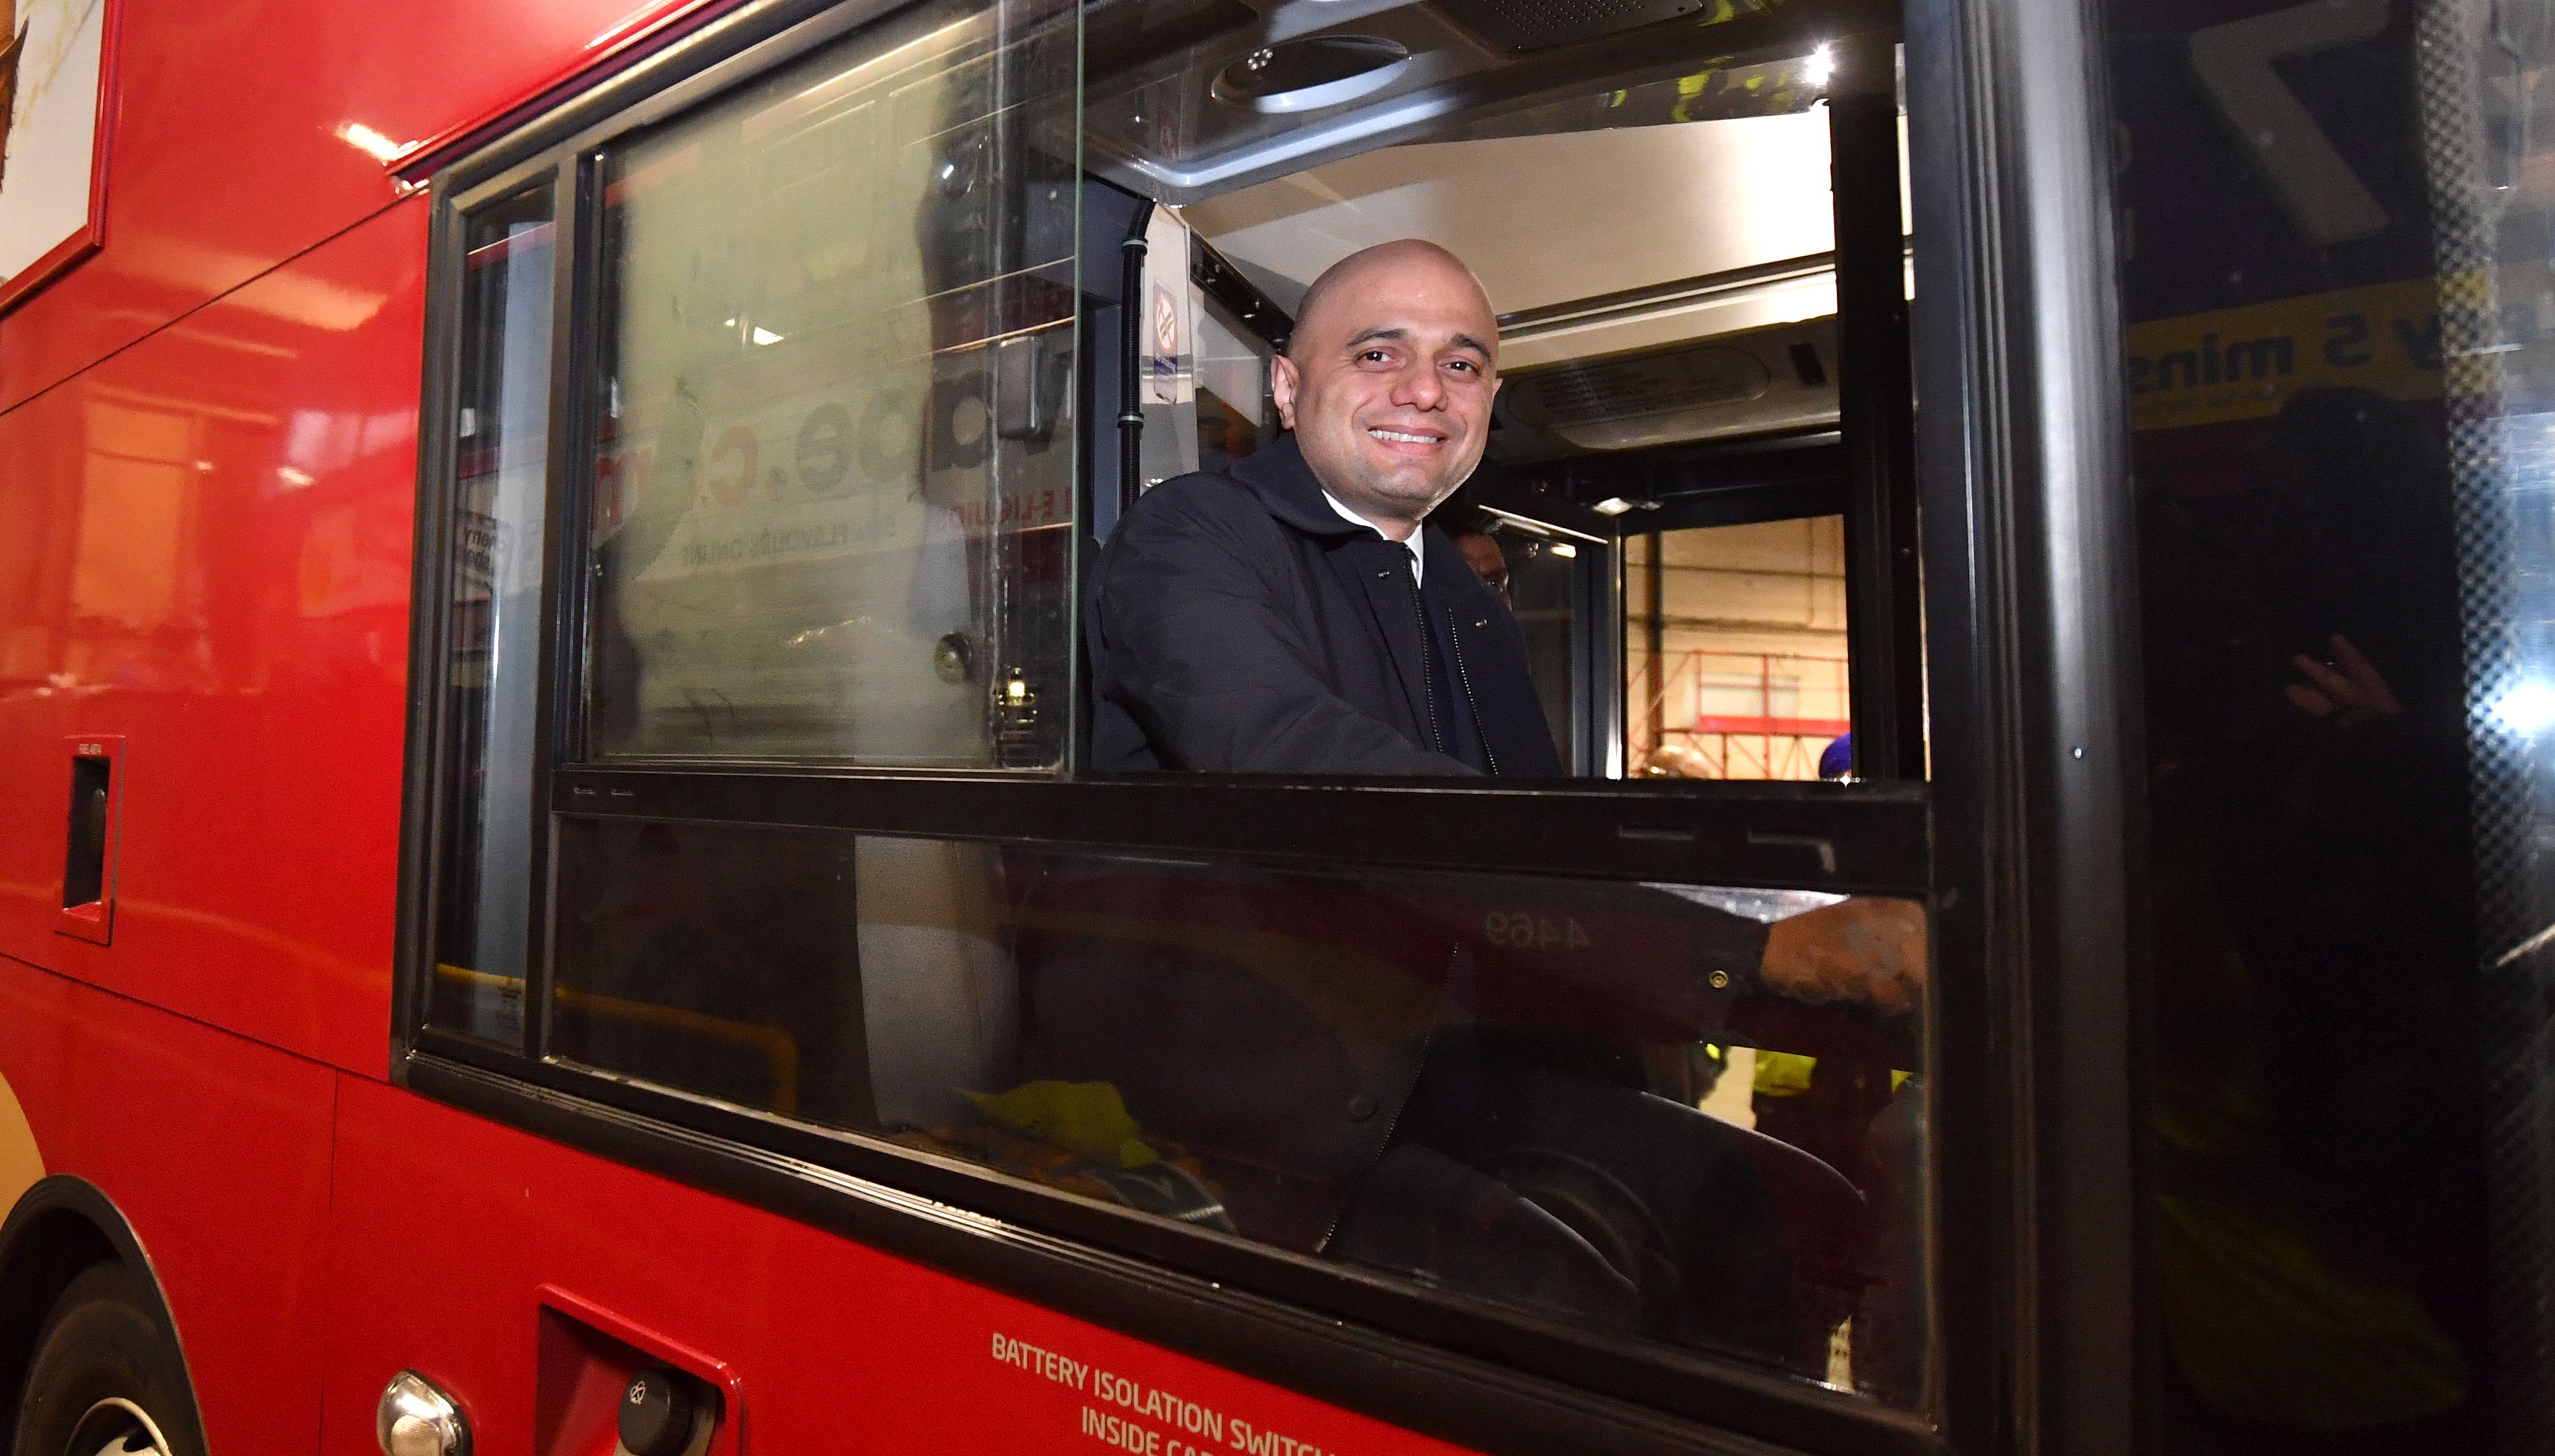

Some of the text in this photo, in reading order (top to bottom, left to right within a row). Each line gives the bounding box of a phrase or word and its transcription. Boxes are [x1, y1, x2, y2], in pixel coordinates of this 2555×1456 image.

[992, 1331, 1089, 1391] BATTERY
[1094, 1368, 1223, 1443] ISOLATION
[1081, 1405, 1161, 1456] INSIDE
